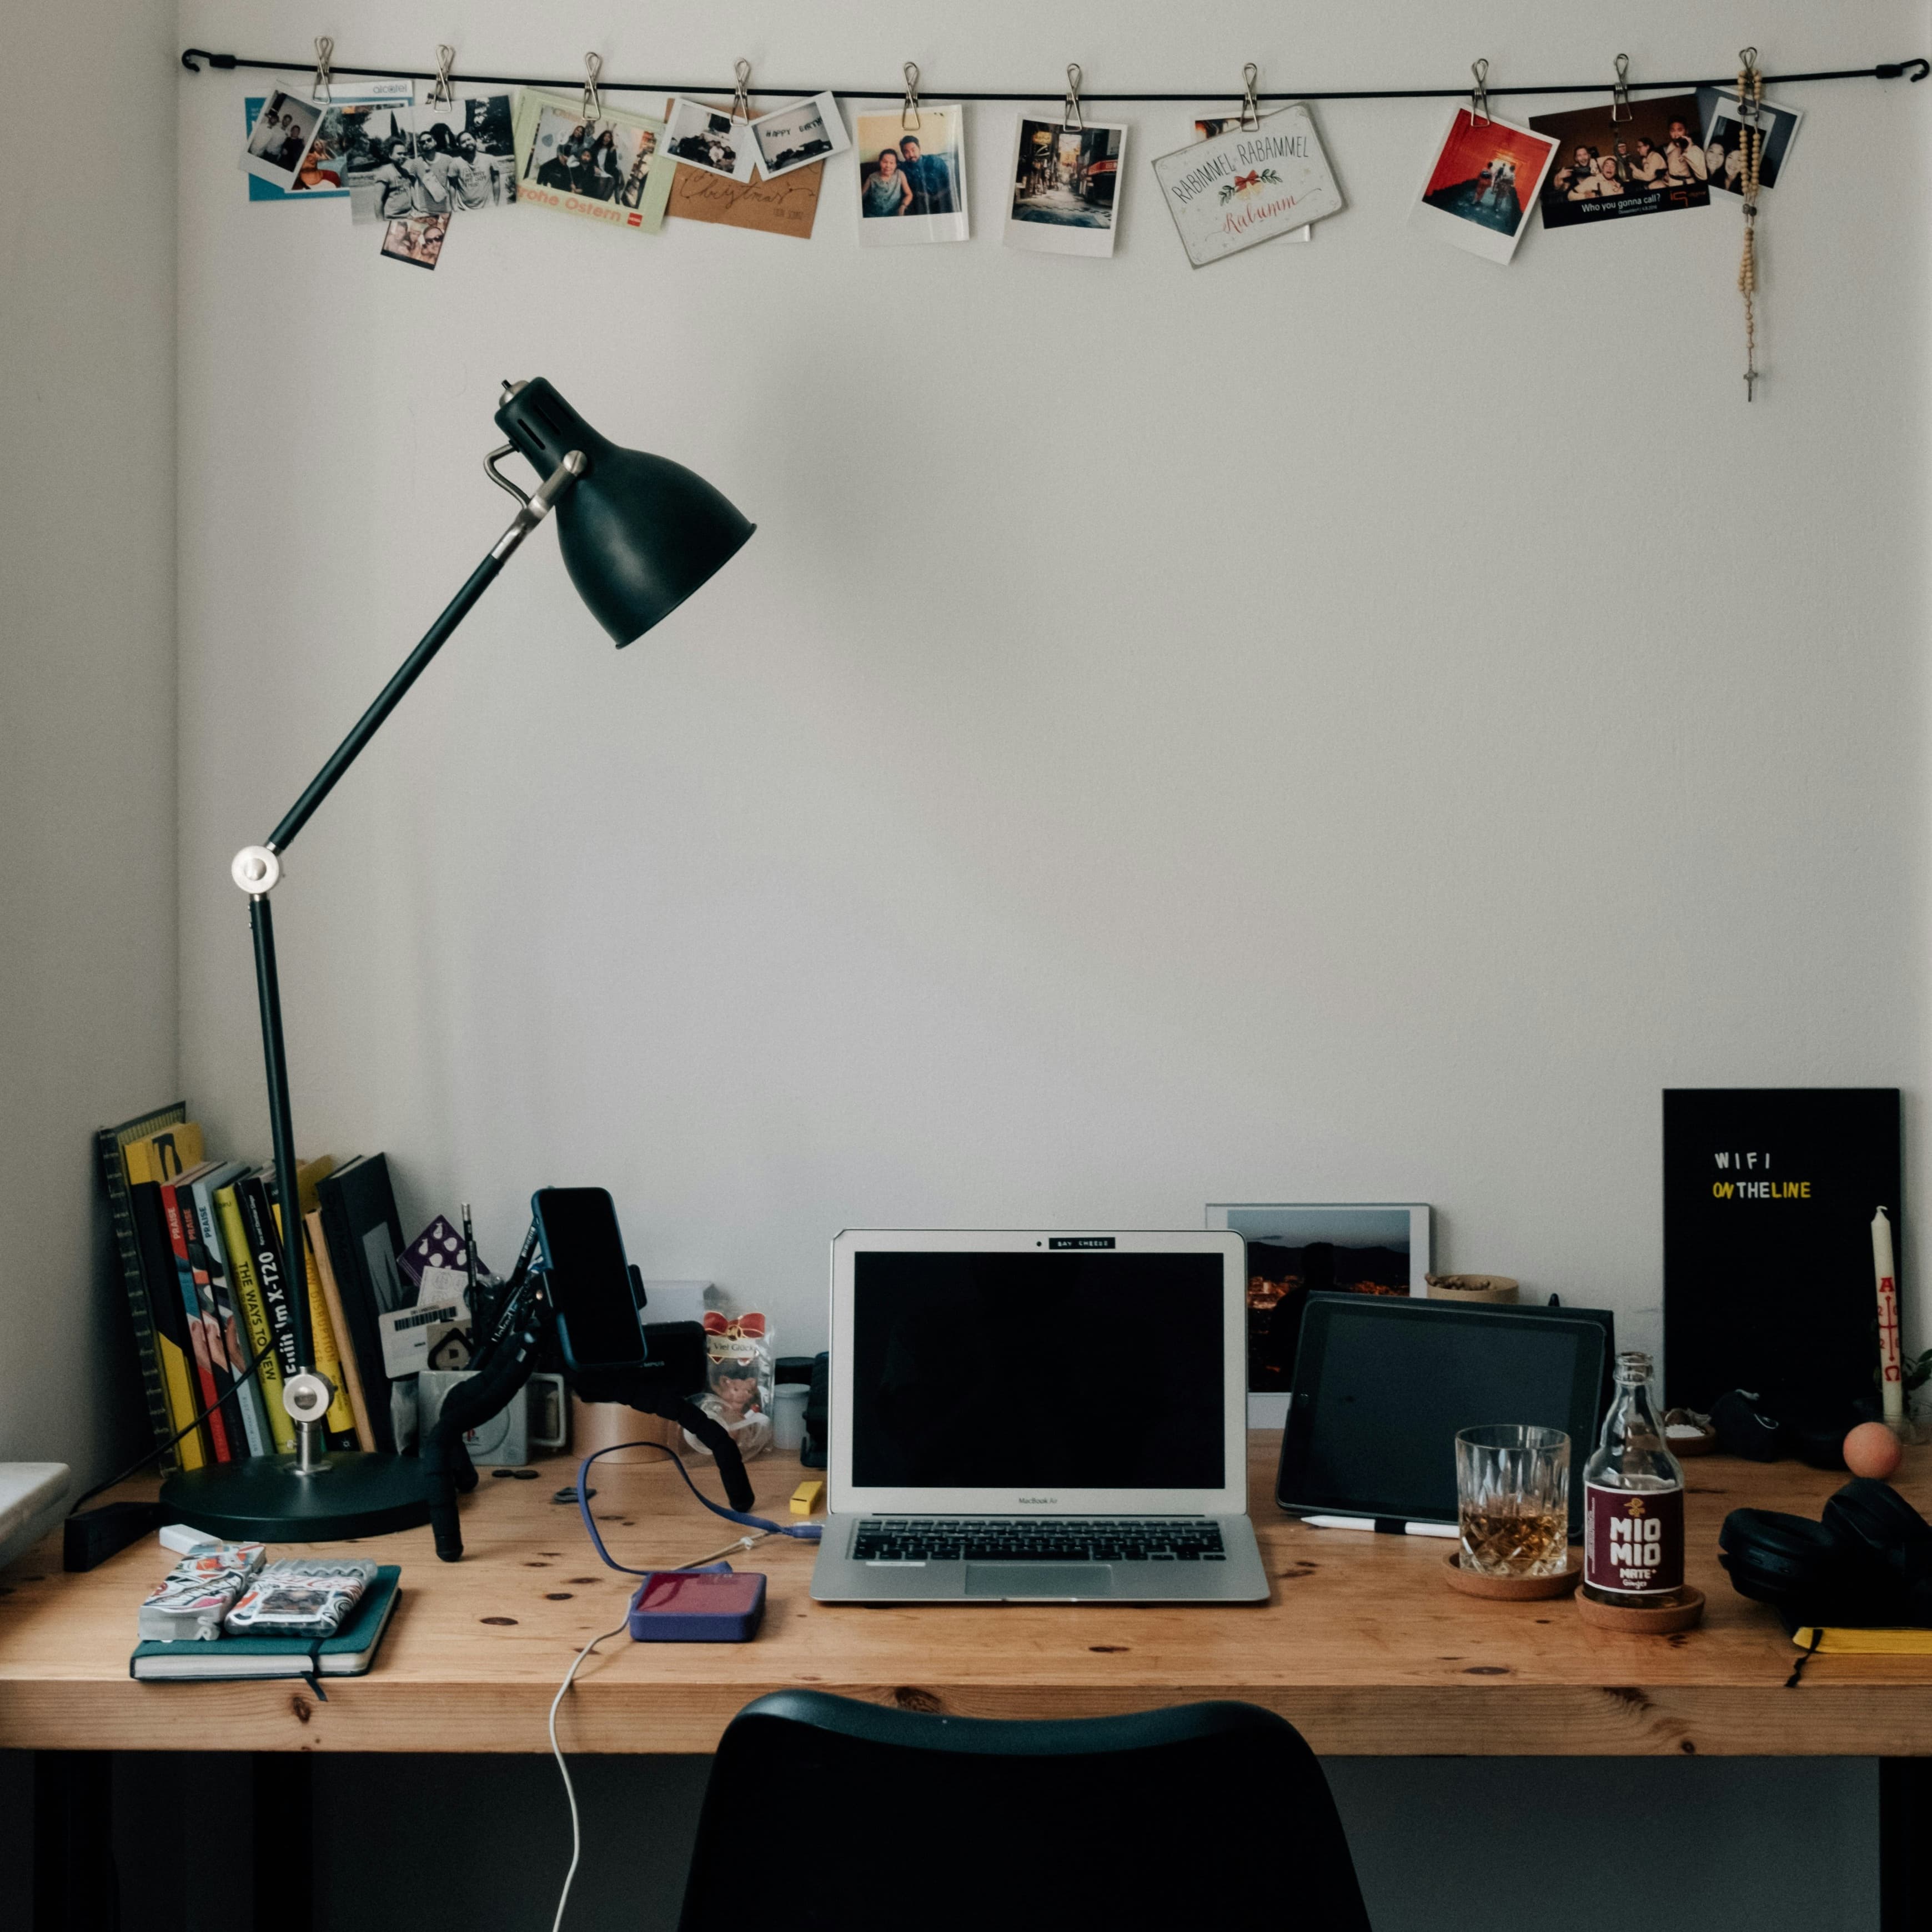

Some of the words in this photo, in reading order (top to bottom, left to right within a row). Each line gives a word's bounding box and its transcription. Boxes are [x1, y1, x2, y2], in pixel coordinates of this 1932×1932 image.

[373, 84, 407, 93] alcatel
[766, 128, 791, 137] HAPPY
[1237, 136, 1309, 165] RABAMMEL
[565, 198, 621, 221] Ostern
[1219, 194, 1305, 235] Rabumm
[1582, 203, 1600, 213] Who
[1602, 201, 1616, 211] you
[1618, 198, 1642, 209] gonna
[1643, 193, 1662, 204] call?
[167, 1206, 181, 1240] PRAISE
[183, 1208, 196, 1241] PRAISE
[199, 1206, 212, 1238] PRAISE
[238, 1261, 253, 1287] THE
[258, 1251, 285, 1303] X-T20
[1879, 1277, 1895, 1293] A
[245, 1289, 263, 1326] WAYS
[255, 1329, 267, 1347] TO
[310, 1291, 337, 1362] DISRUPTION
[1610, 1517, 1661, 1542] MIO
[1610, 1542, 1661, 1567] MIO
[1622, 1579, 1647, 1589] Ginger
